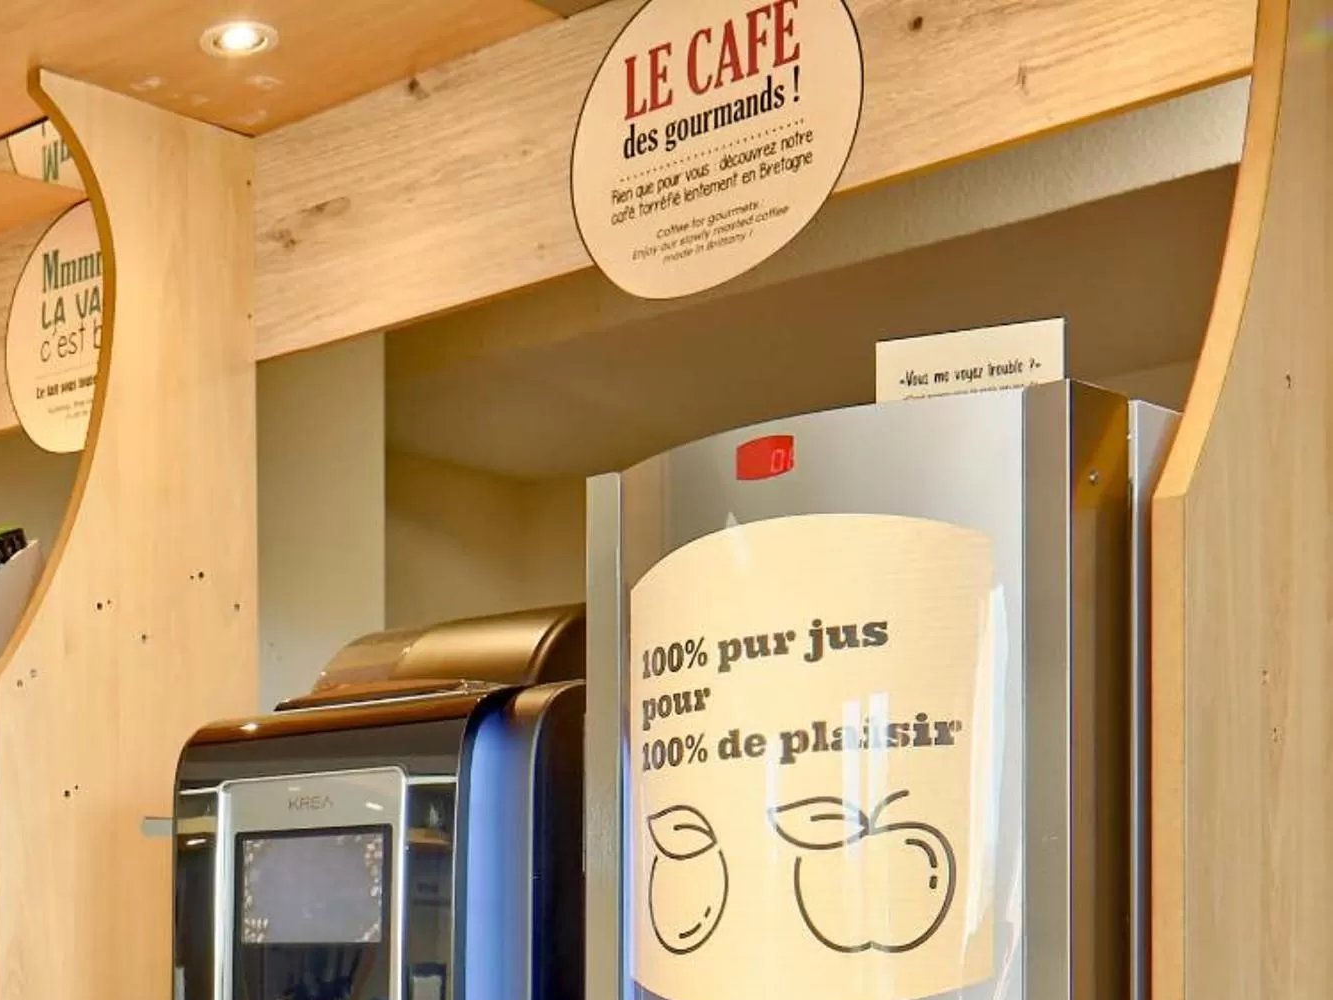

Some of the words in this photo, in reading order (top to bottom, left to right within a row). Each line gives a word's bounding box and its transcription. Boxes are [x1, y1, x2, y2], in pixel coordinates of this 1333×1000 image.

[624, 42, 673, 121] LE
[623, 123, 659, 160] des
[665, 74, 786, 152] gourmands
[793, 65, 800, 102] !
[611, 188, 634, 206] Rien
[636, 182, 654, 199] que
[657, 173, 681, 195] pour
[685, 163, 710, 182] vous
[719, 142, 777, 171] découvrez
[781, 130, 814, 151] notre
[611, 205, 635, 225] café
[684, 172, 738, 202] lentement
[742, 170, 756, 184] en
[759, 151, 813, 180] Bretagne
[41, 297, 66, 330] LA
[75, 284, 102, 319] VA
[40, 320, 86, 363] c'est
[934, 371, 949, 384] me
[987, 358, 1023, 377] trouble
[642, 637, 709, 680] 100%
[717, 629, 797, 674] pur
[803, 618, 890, 663] jus
[641, 687, 711, 732] pour
[642, 732, 709, 773] 100%
[717, 728, 767, 761] de
[779, 712, 963, 765] plaisir
